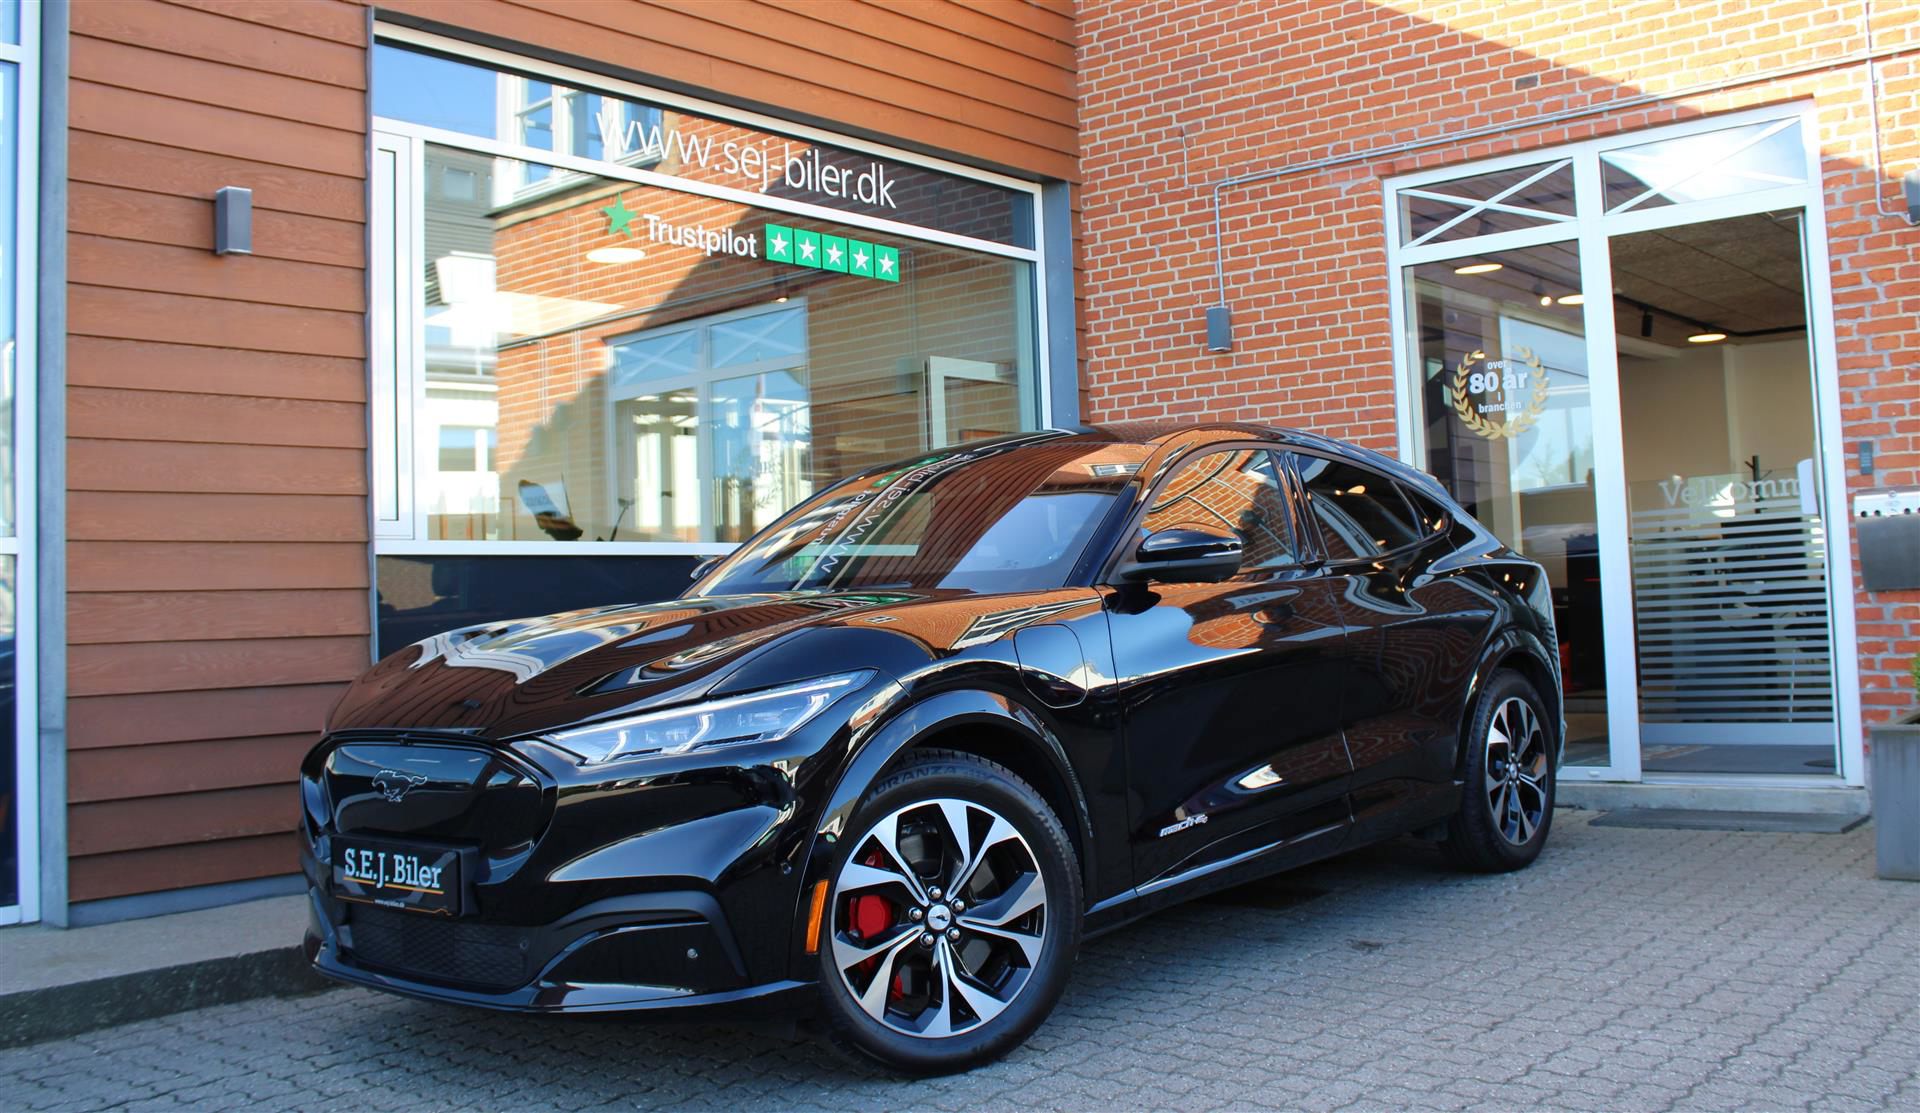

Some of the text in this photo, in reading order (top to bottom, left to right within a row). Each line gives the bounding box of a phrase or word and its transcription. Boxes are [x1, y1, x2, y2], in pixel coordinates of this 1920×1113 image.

[596, 112, 897, 209] www.sej-biler.dk
[643, 213, 758, 258] Trustpilot
[1469, 368, 1528, 394] 80 år
[1487, 359, 1507, 370] over
[1478, 401, 1522, 413] branchen
[344, 847, 442, 888] S.E.J. Biler
